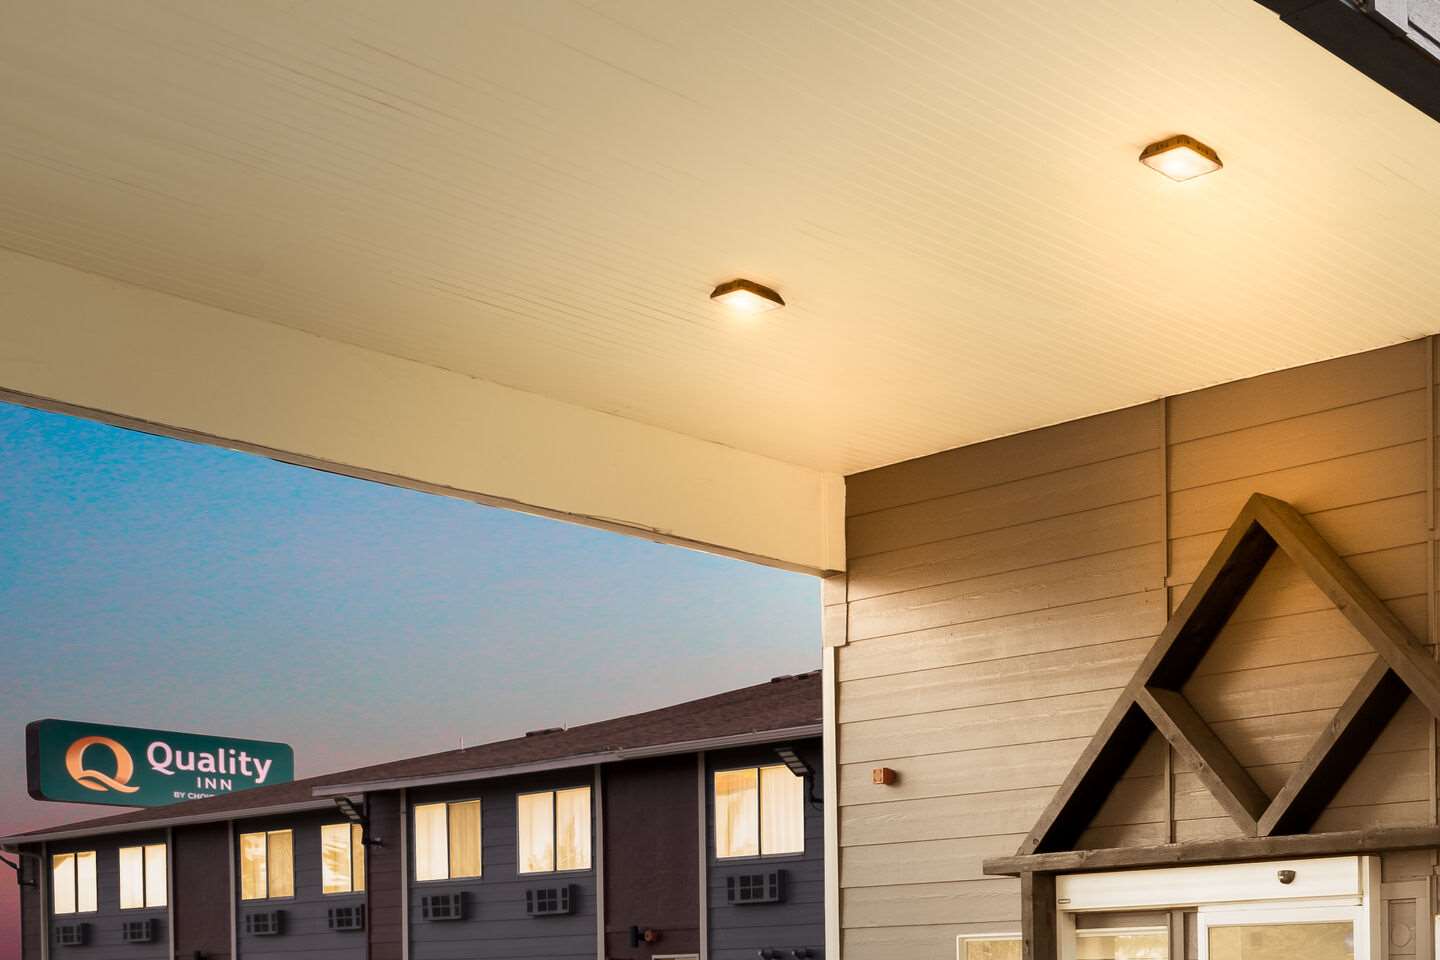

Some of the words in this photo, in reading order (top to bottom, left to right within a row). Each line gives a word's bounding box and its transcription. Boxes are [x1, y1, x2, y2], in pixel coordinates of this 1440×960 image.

[65, 736, 140, 793] Q
[146, 741, 272, 784] Quality
[173, 791, 186, 799] BY
[197, 776, 232, 791] INN
